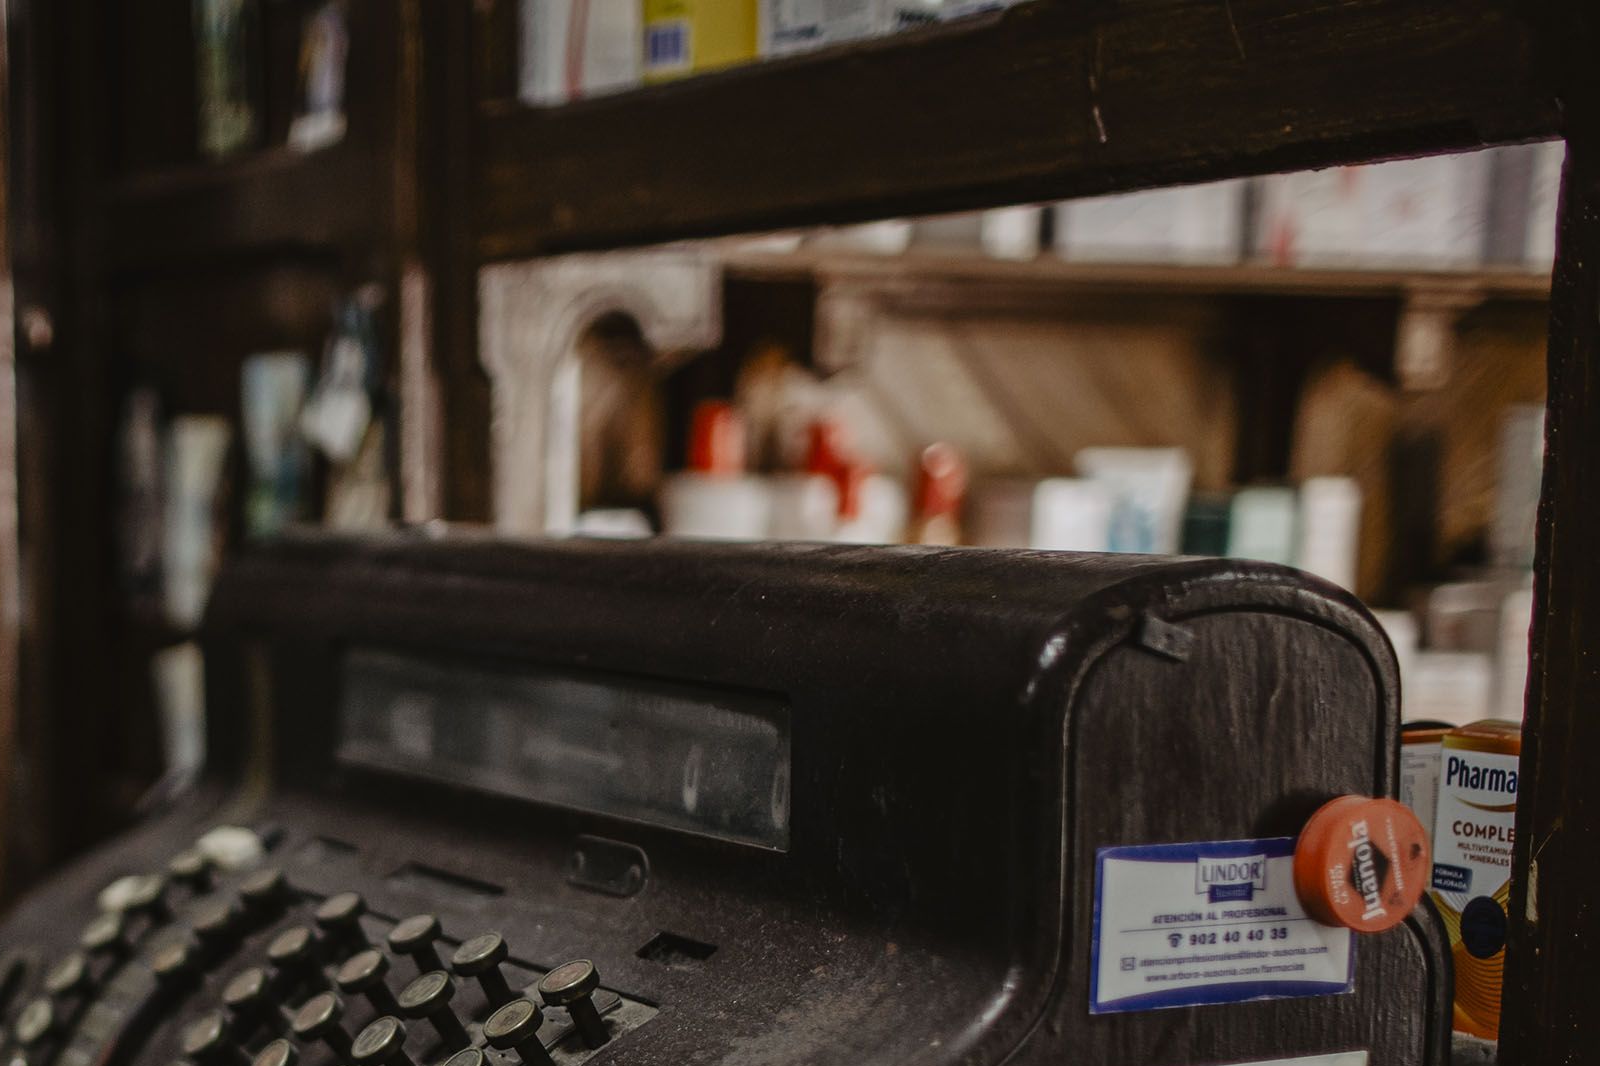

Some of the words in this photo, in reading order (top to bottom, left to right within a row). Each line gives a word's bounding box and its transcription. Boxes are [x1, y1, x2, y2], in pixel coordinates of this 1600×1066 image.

[1347, 819, 1388, 921] Juanola
[1469, 854, 1510, 867] MINERALES
[1202, 862, 1260, 882] LINDOR
[1206, 909, 1218, 920] AL
[1221, 906, 1287, 919] PROFESIONAL
[1189, 932, 1217, 946] 902
[1222, 930, 1241, 944] 40
[1246, 929, 1265, 942] 40
[1269, 927, 1288, 940] 35
